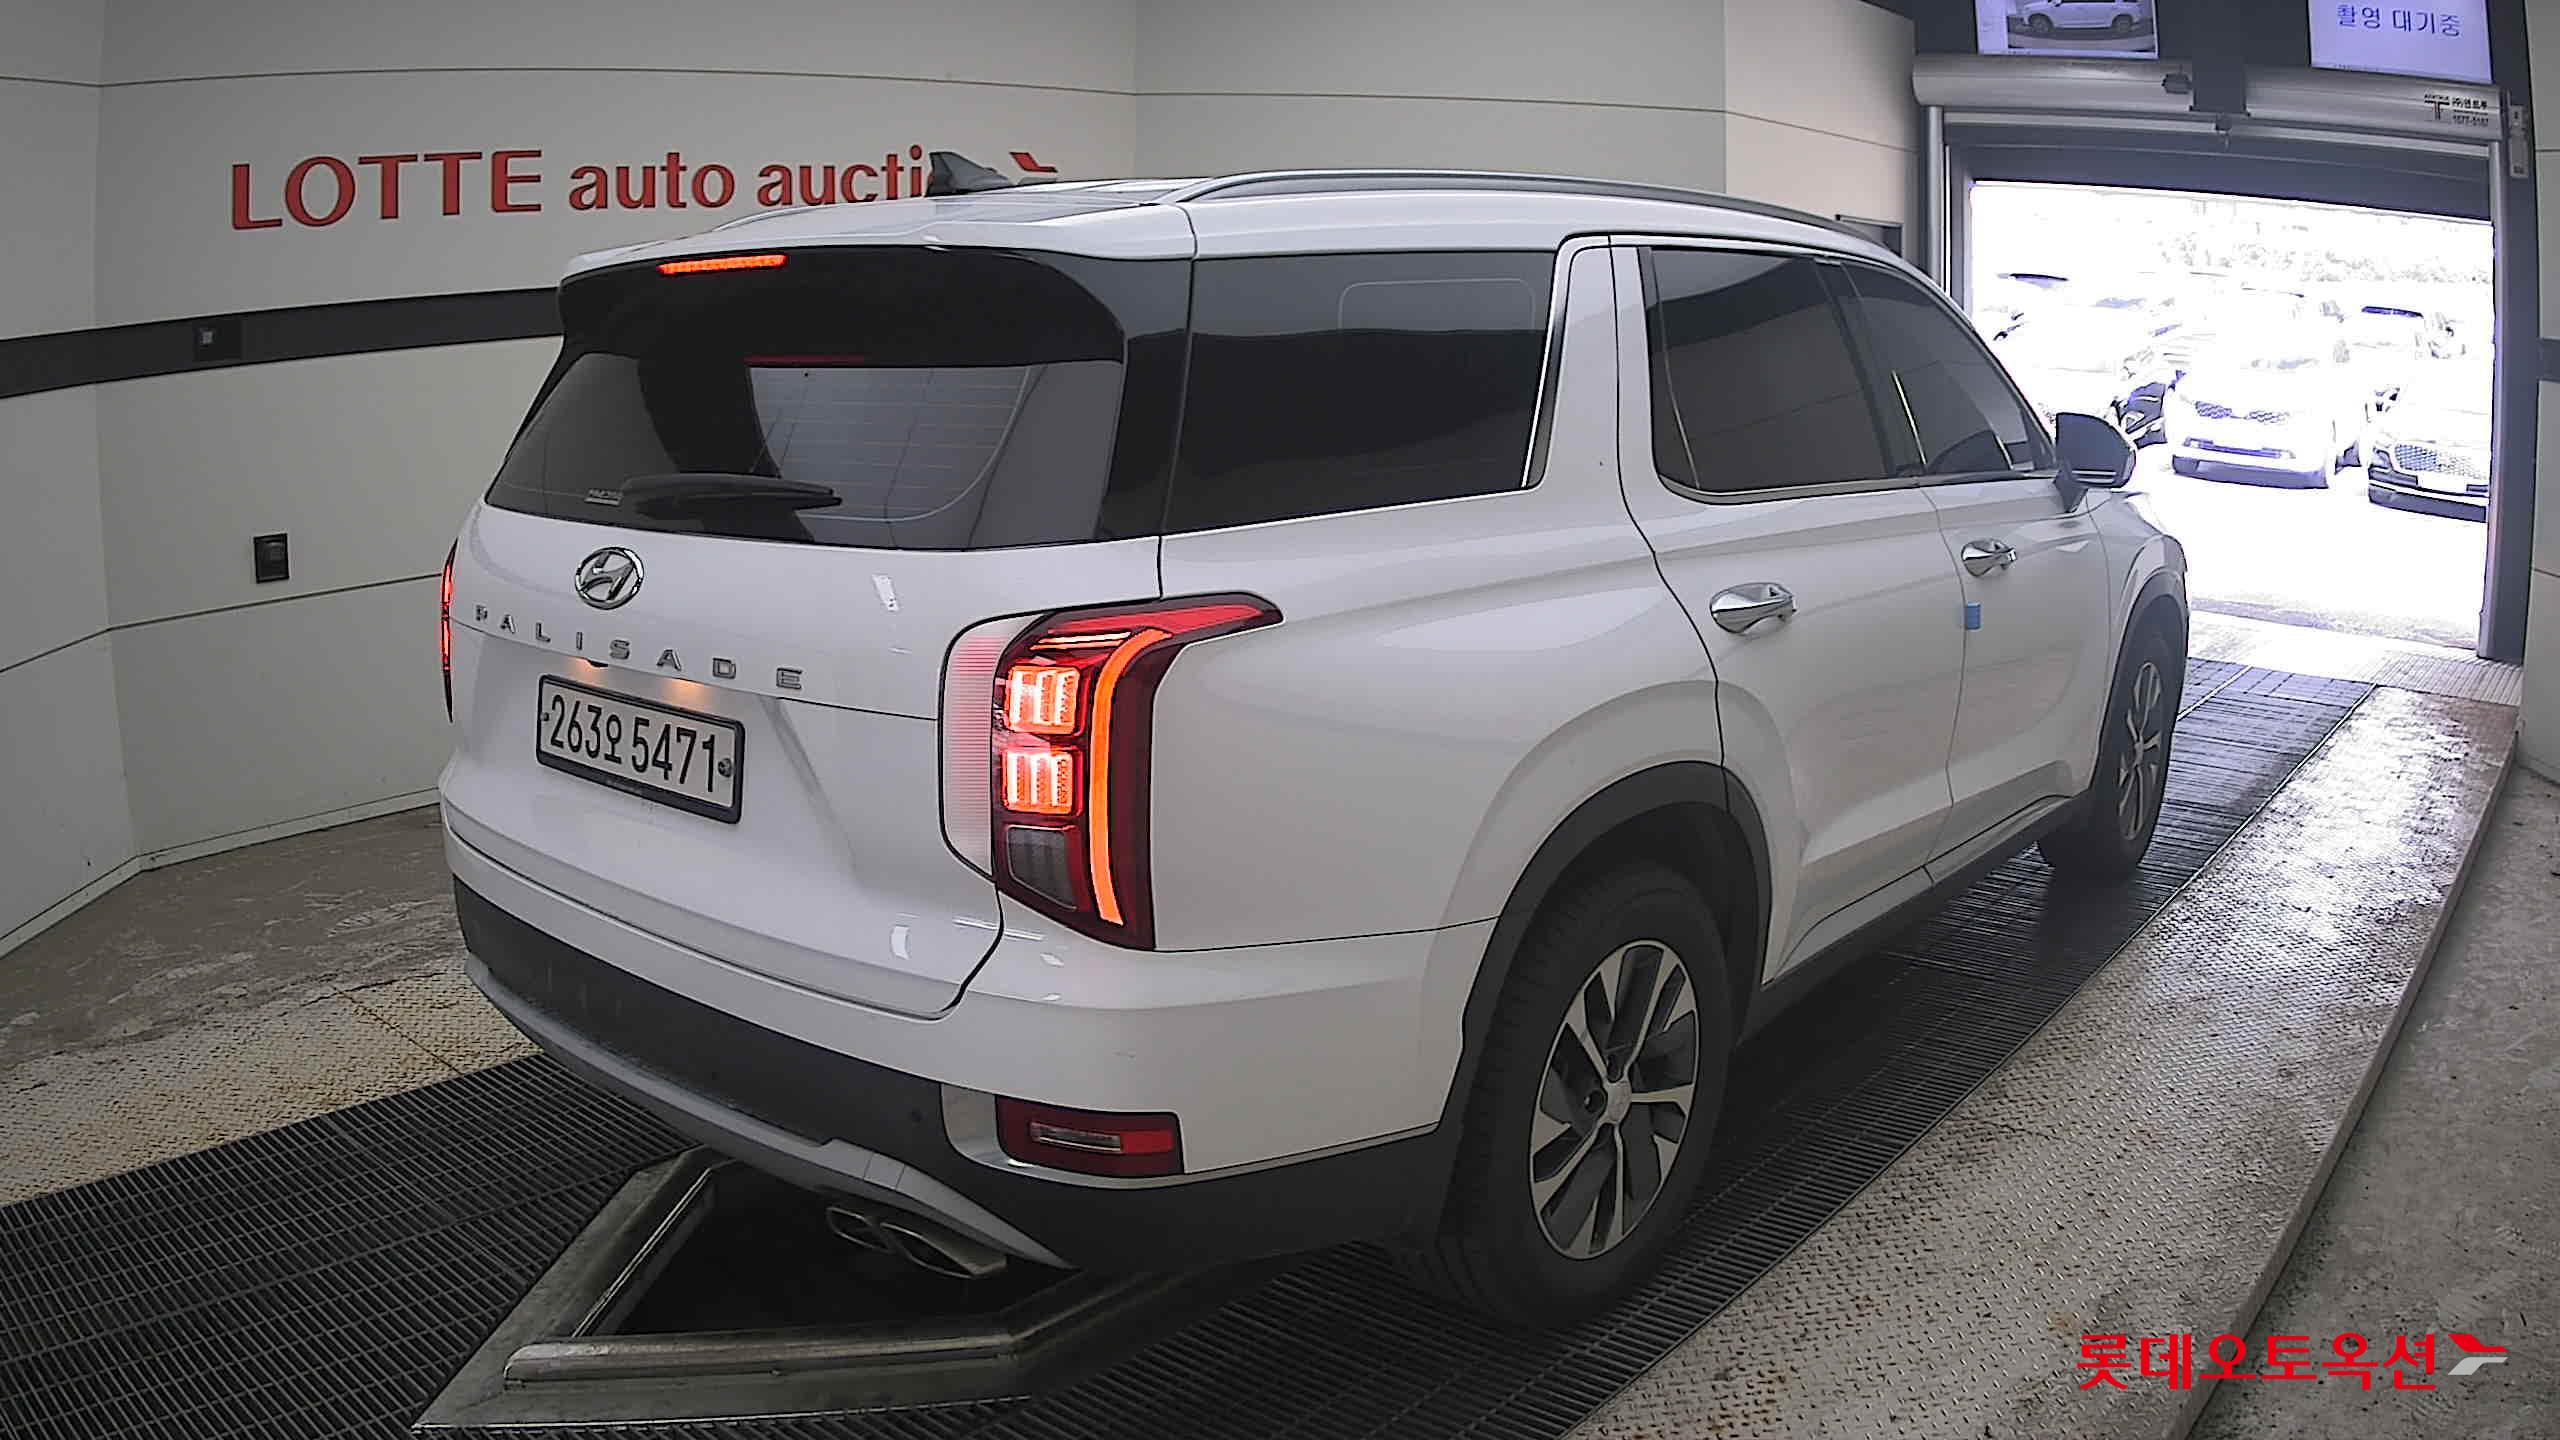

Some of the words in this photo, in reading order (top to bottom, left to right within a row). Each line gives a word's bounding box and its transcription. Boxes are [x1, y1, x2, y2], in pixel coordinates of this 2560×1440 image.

[2337, 4, 2381, 29] 촬영
[2392, 9, 2462, 37] 대기중
[232, 149, 542, 230] LOTTE
[569, 151, 735, 210] auto
[757, 145, 930, 207] aucti
[475, 604, 804, 689] PALISADE
[549, 693, 623, 765] 263오
[631, 717, 716, 793] 5471
